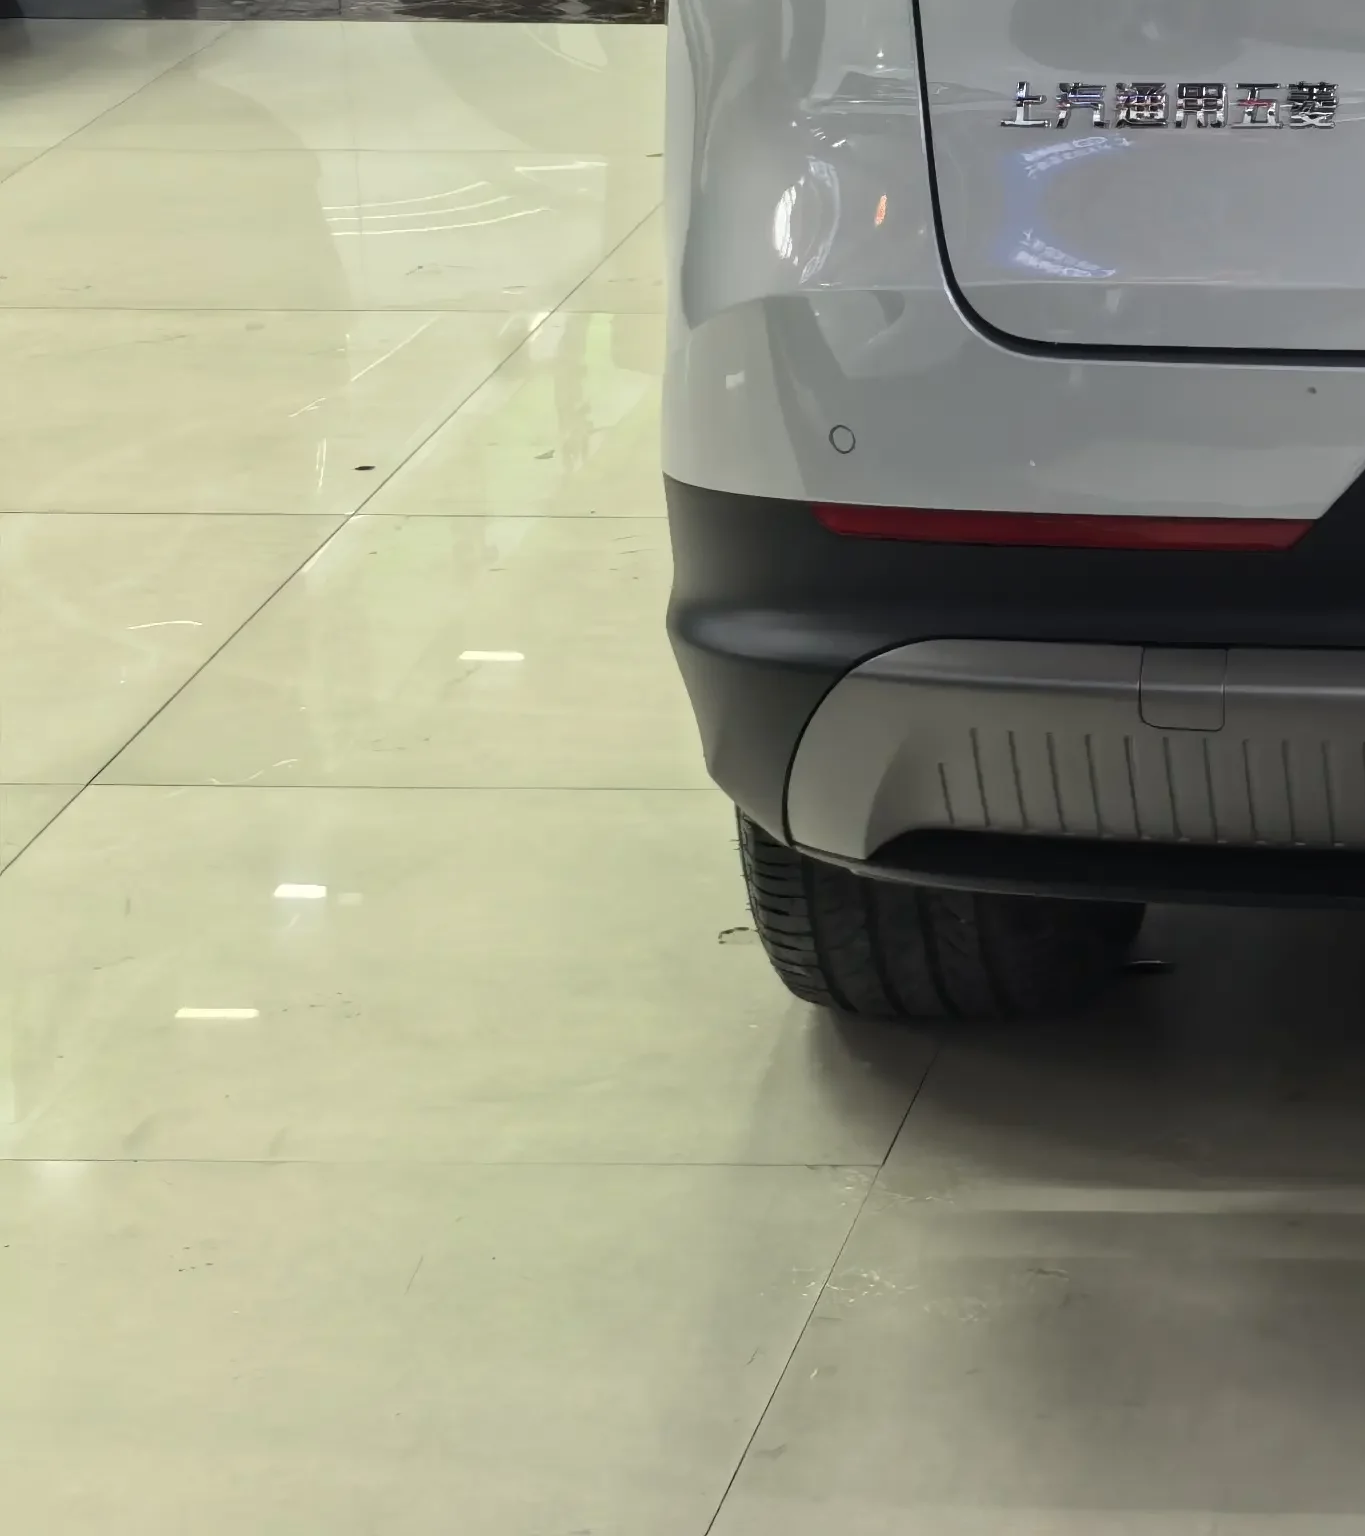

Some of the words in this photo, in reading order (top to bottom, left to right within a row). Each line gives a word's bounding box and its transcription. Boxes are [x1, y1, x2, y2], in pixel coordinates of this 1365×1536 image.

[1000, 80, 1340, 130] 上汽通用五菱
